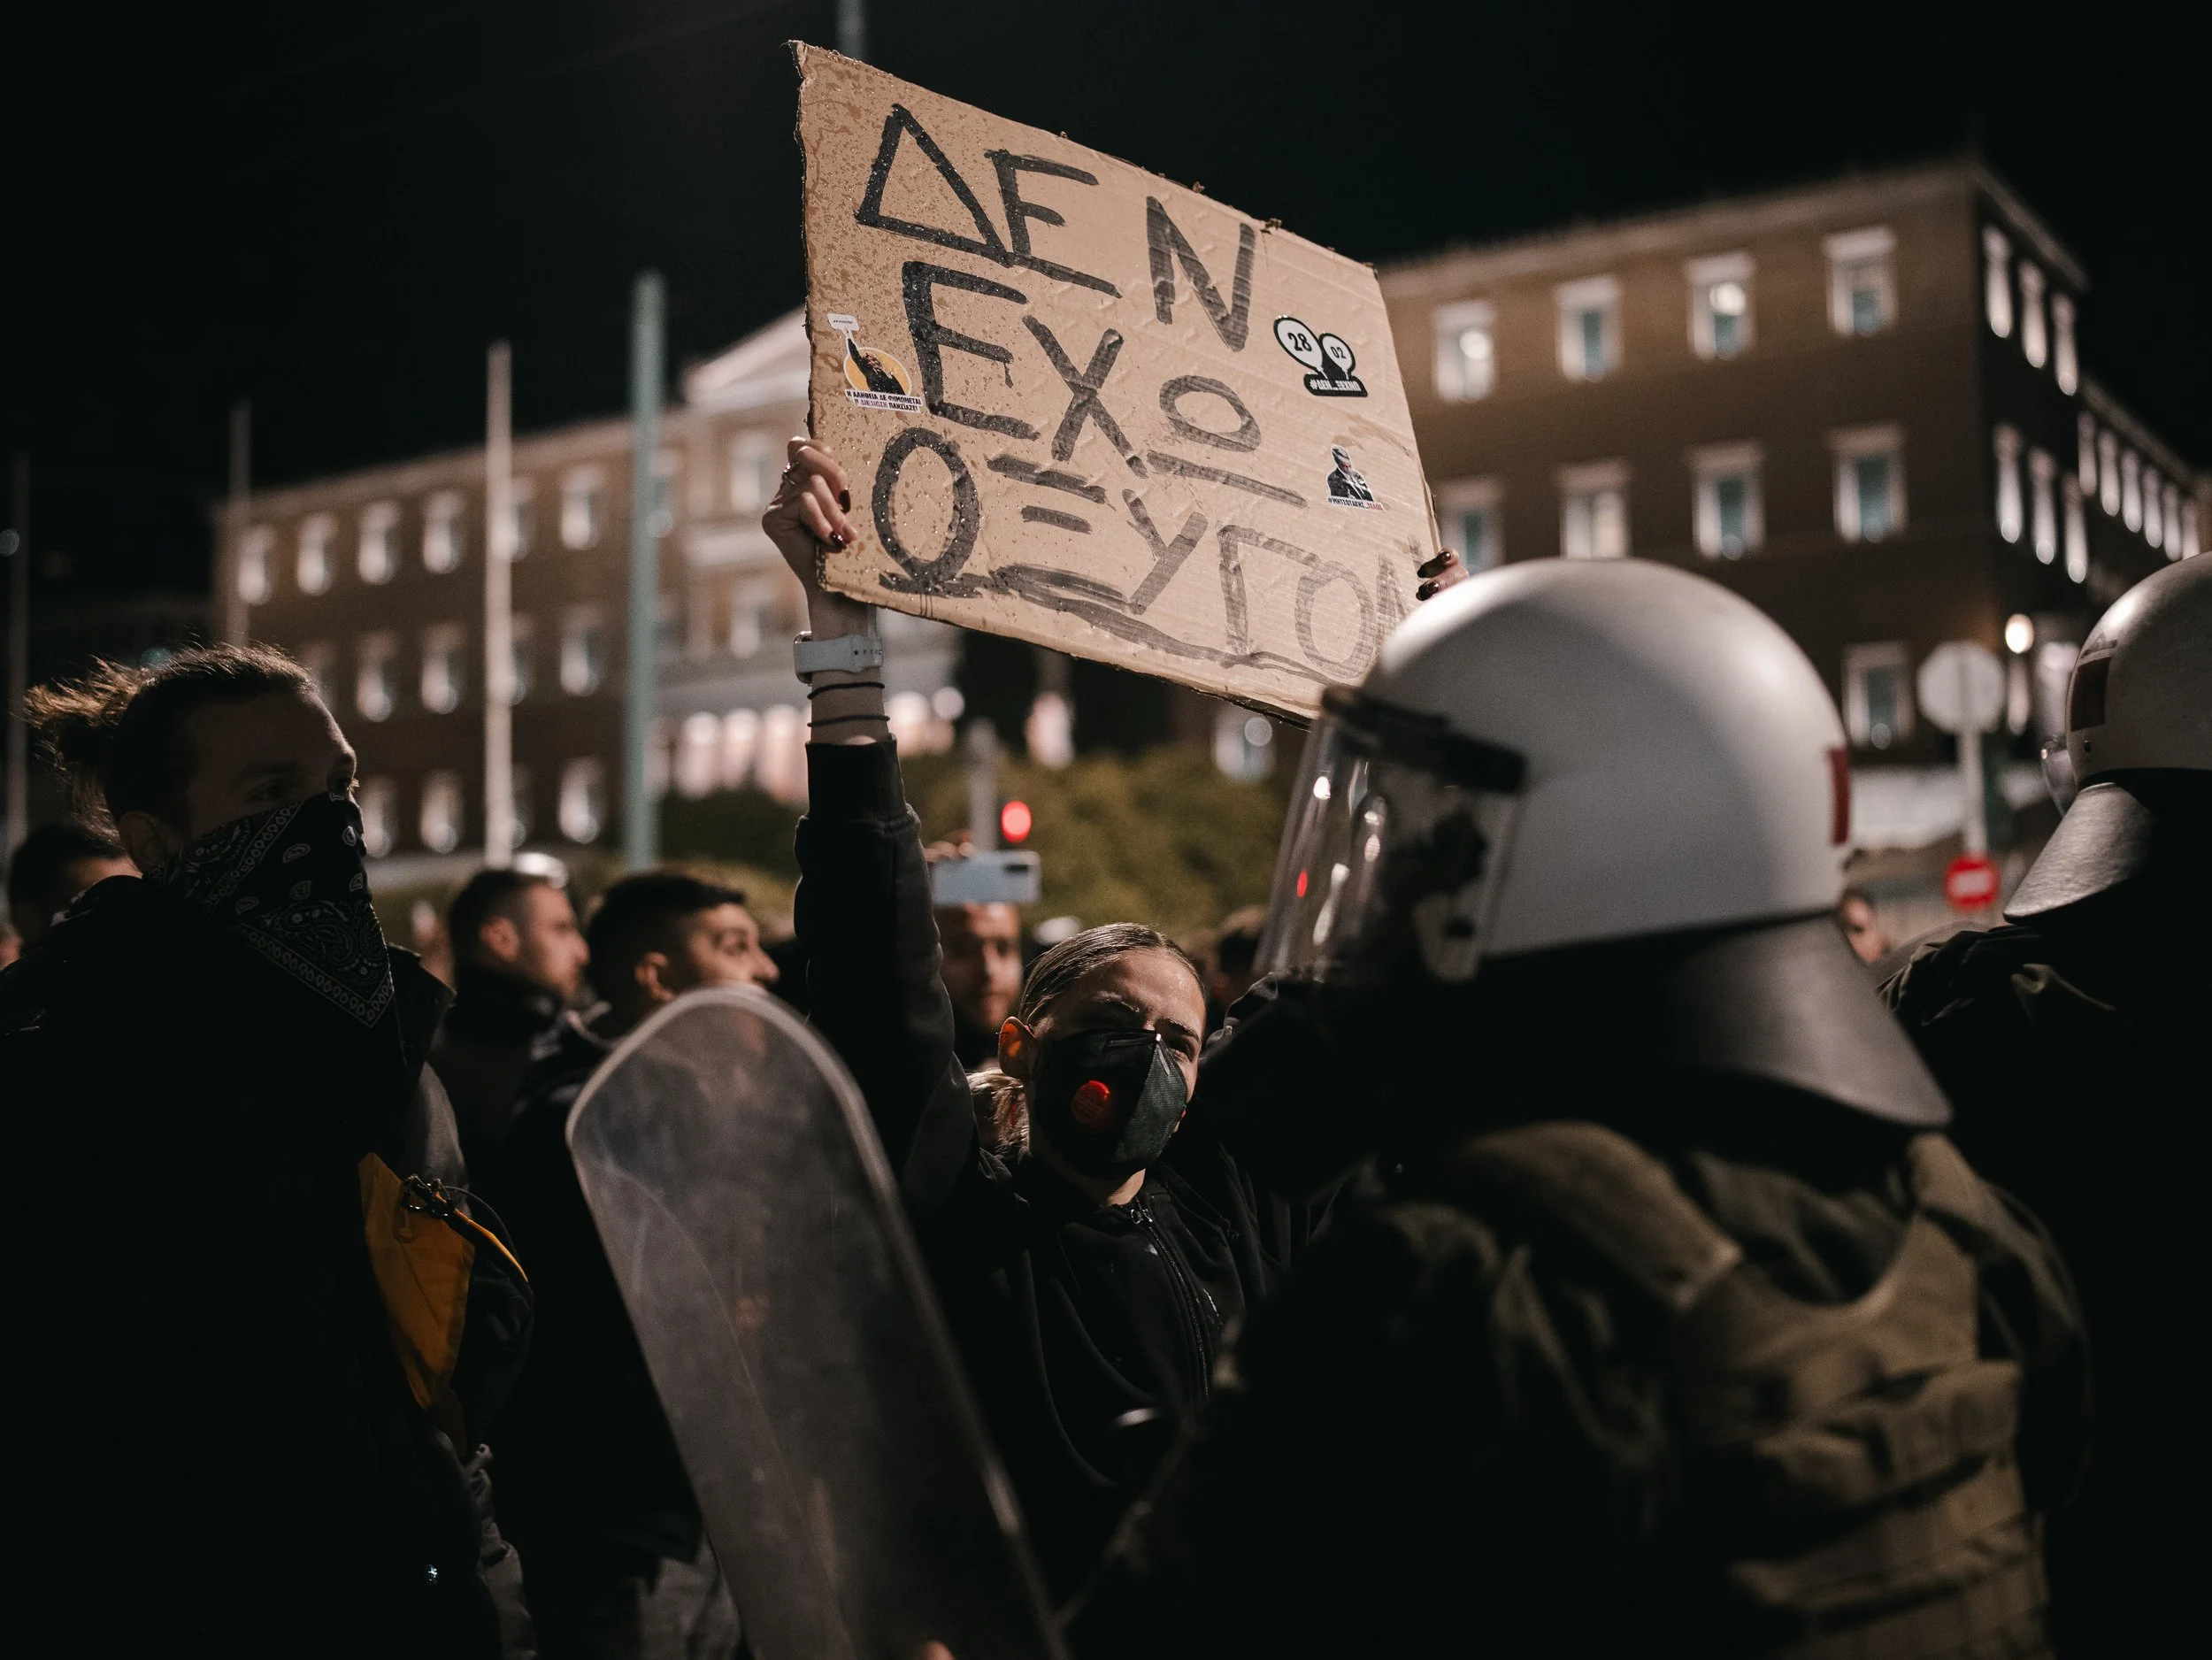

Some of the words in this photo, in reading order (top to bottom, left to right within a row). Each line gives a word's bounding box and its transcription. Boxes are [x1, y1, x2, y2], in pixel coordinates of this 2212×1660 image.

[854, 102, 1256, 351] ΔΕΝ
[1287, 332, 1312, 351] 28
[1330, 346, 1346, 359] 02
[853, 391, 879, 400] ΑΛΗΘΕΙΑ
